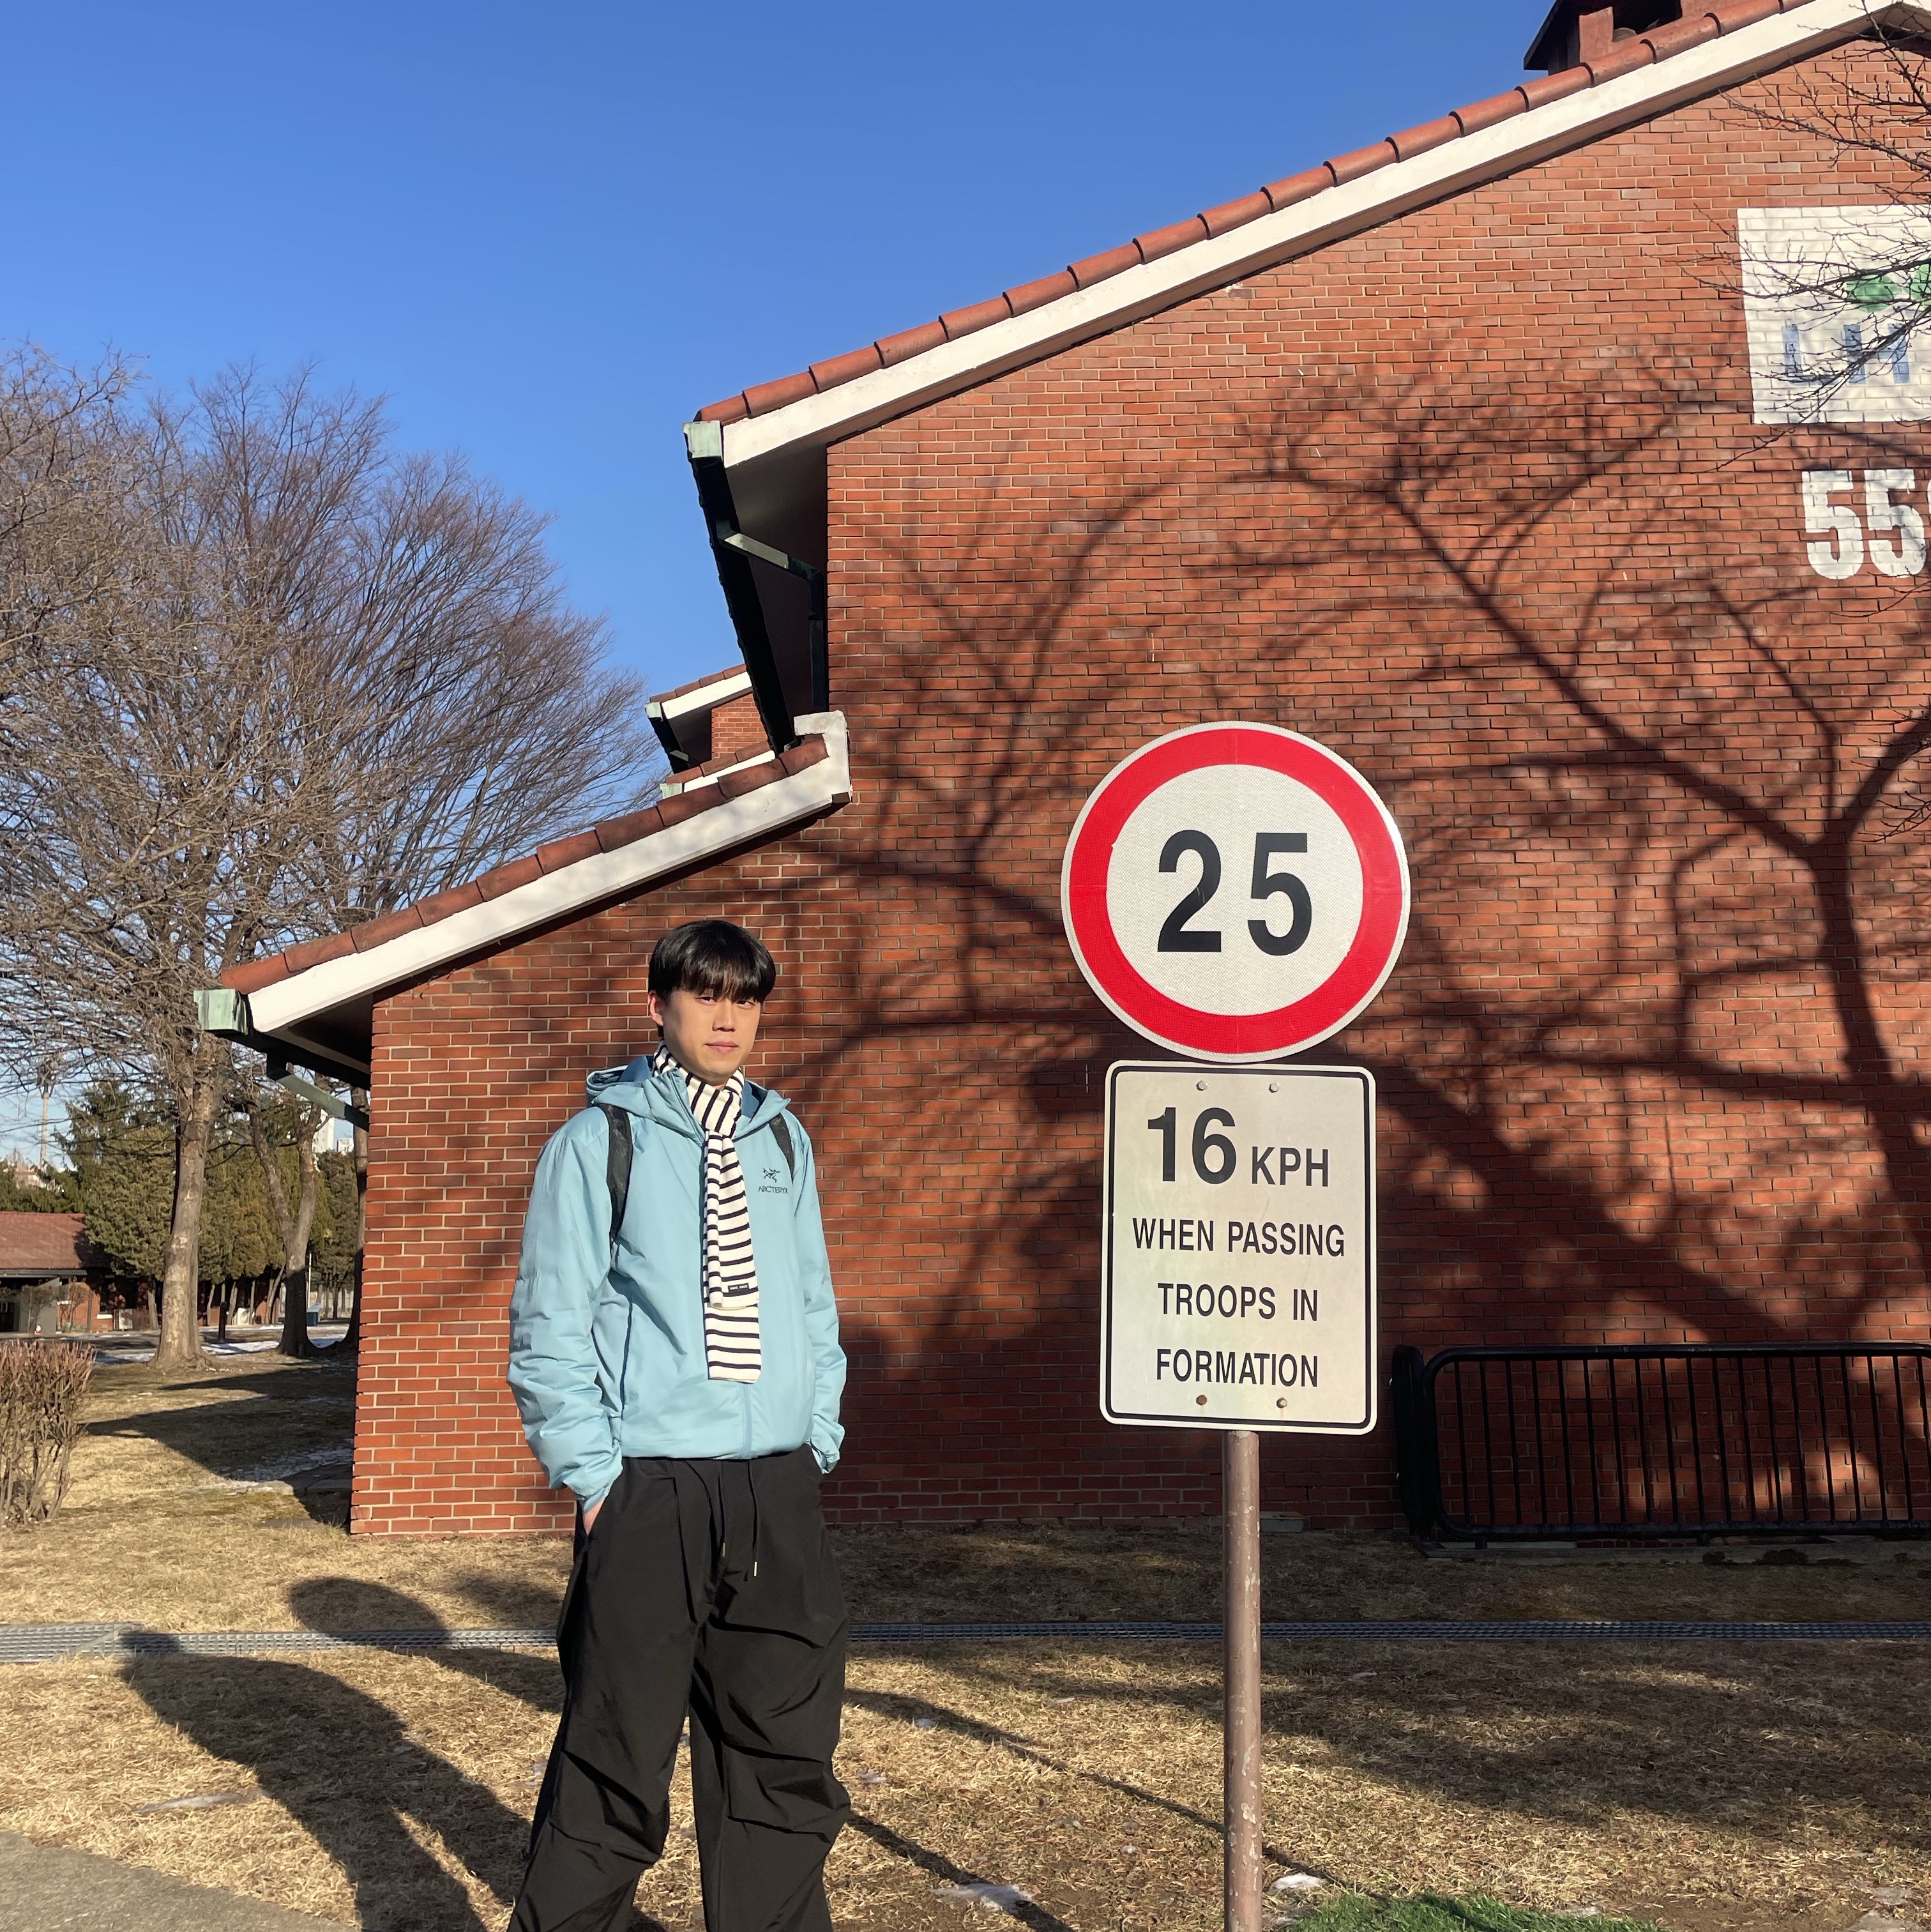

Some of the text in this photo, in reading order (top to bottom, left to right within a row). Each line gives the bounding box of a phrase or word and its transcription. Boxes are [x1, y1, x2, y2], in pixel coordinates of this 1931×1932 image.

[1801, 469, 1931, 580] 55
[1158, 830, 1312, 956] 25
[1148, 1107, 1329, 1187] 16 KPH
[1132, 1217, 1344, 1257] WHEN PASSING
[1157, 1282, 1317, 1321] TROOPS IN
[1156, 1348, 1318, 1387] FORMATION
